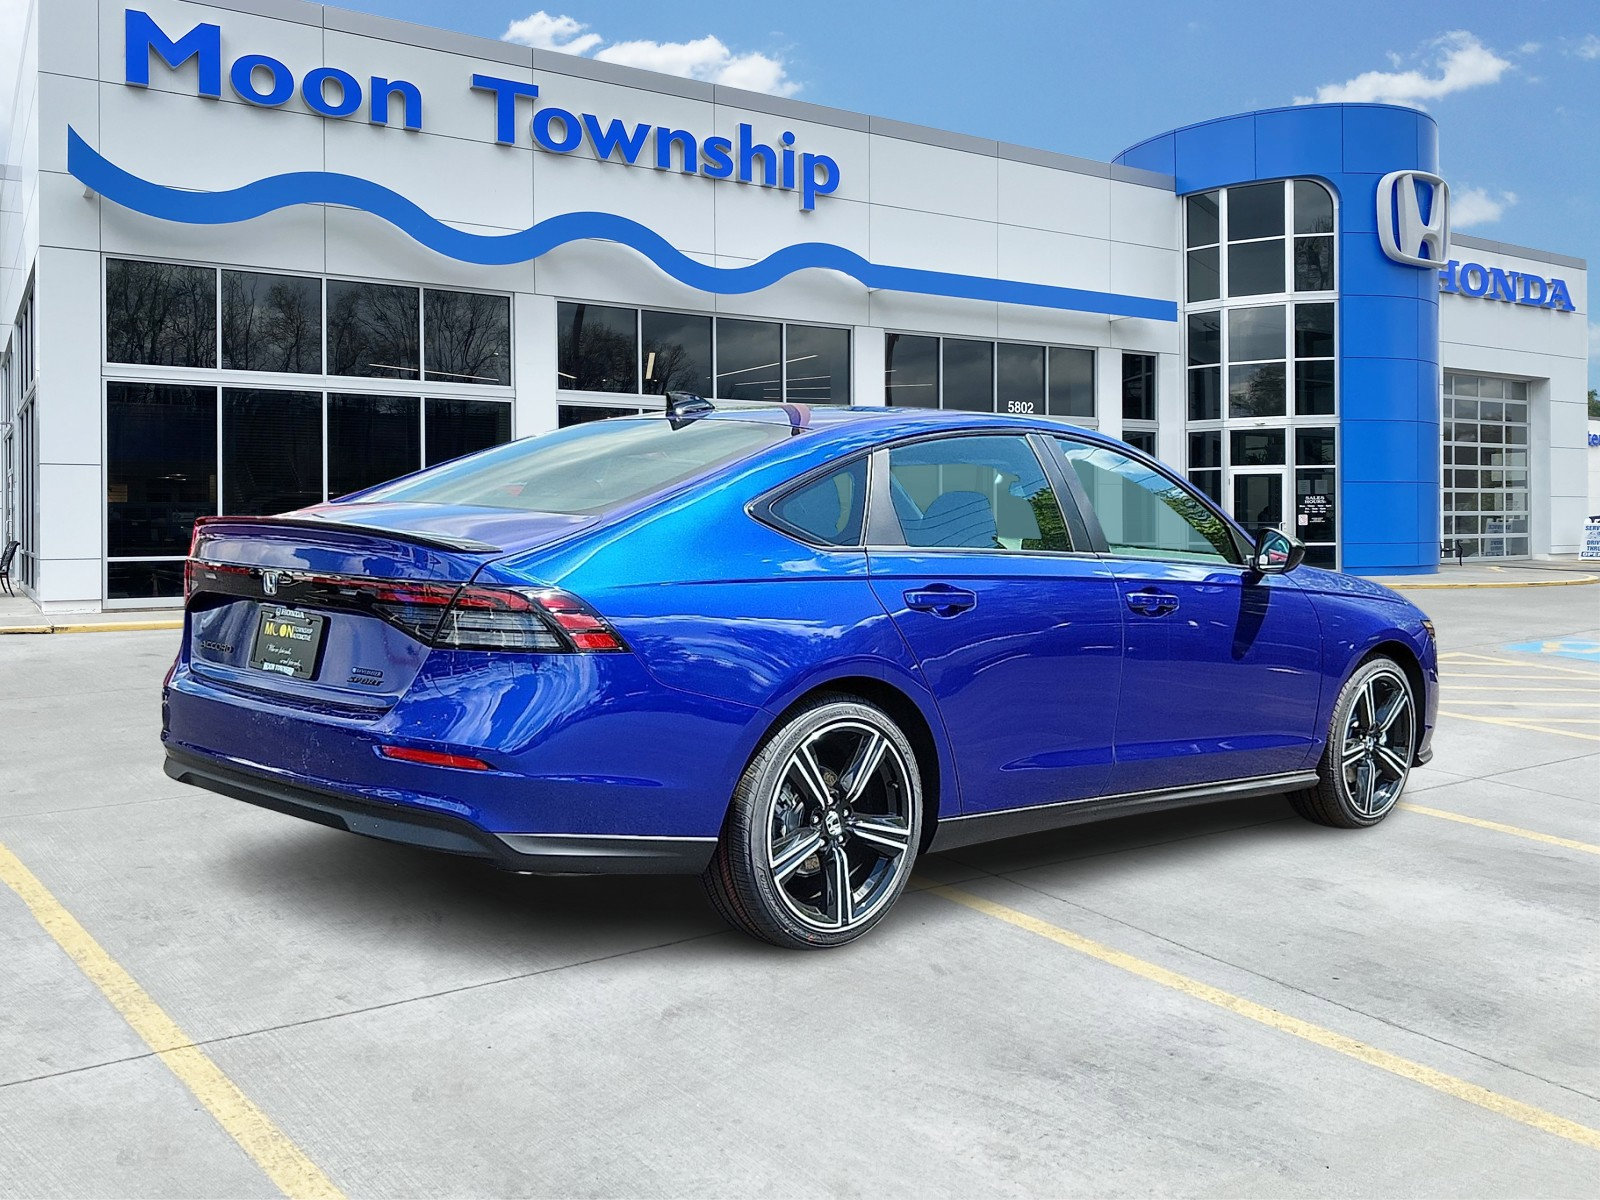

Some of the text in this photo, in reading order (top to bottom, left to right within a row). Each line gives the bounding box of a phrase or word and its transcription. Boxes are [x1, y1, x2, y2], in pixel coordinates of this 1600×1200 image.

[125, 8, 841, 212] Moon Township
[1007, 400, 1034, 414] 5802
[281, 608, 305, 618] HONDA
